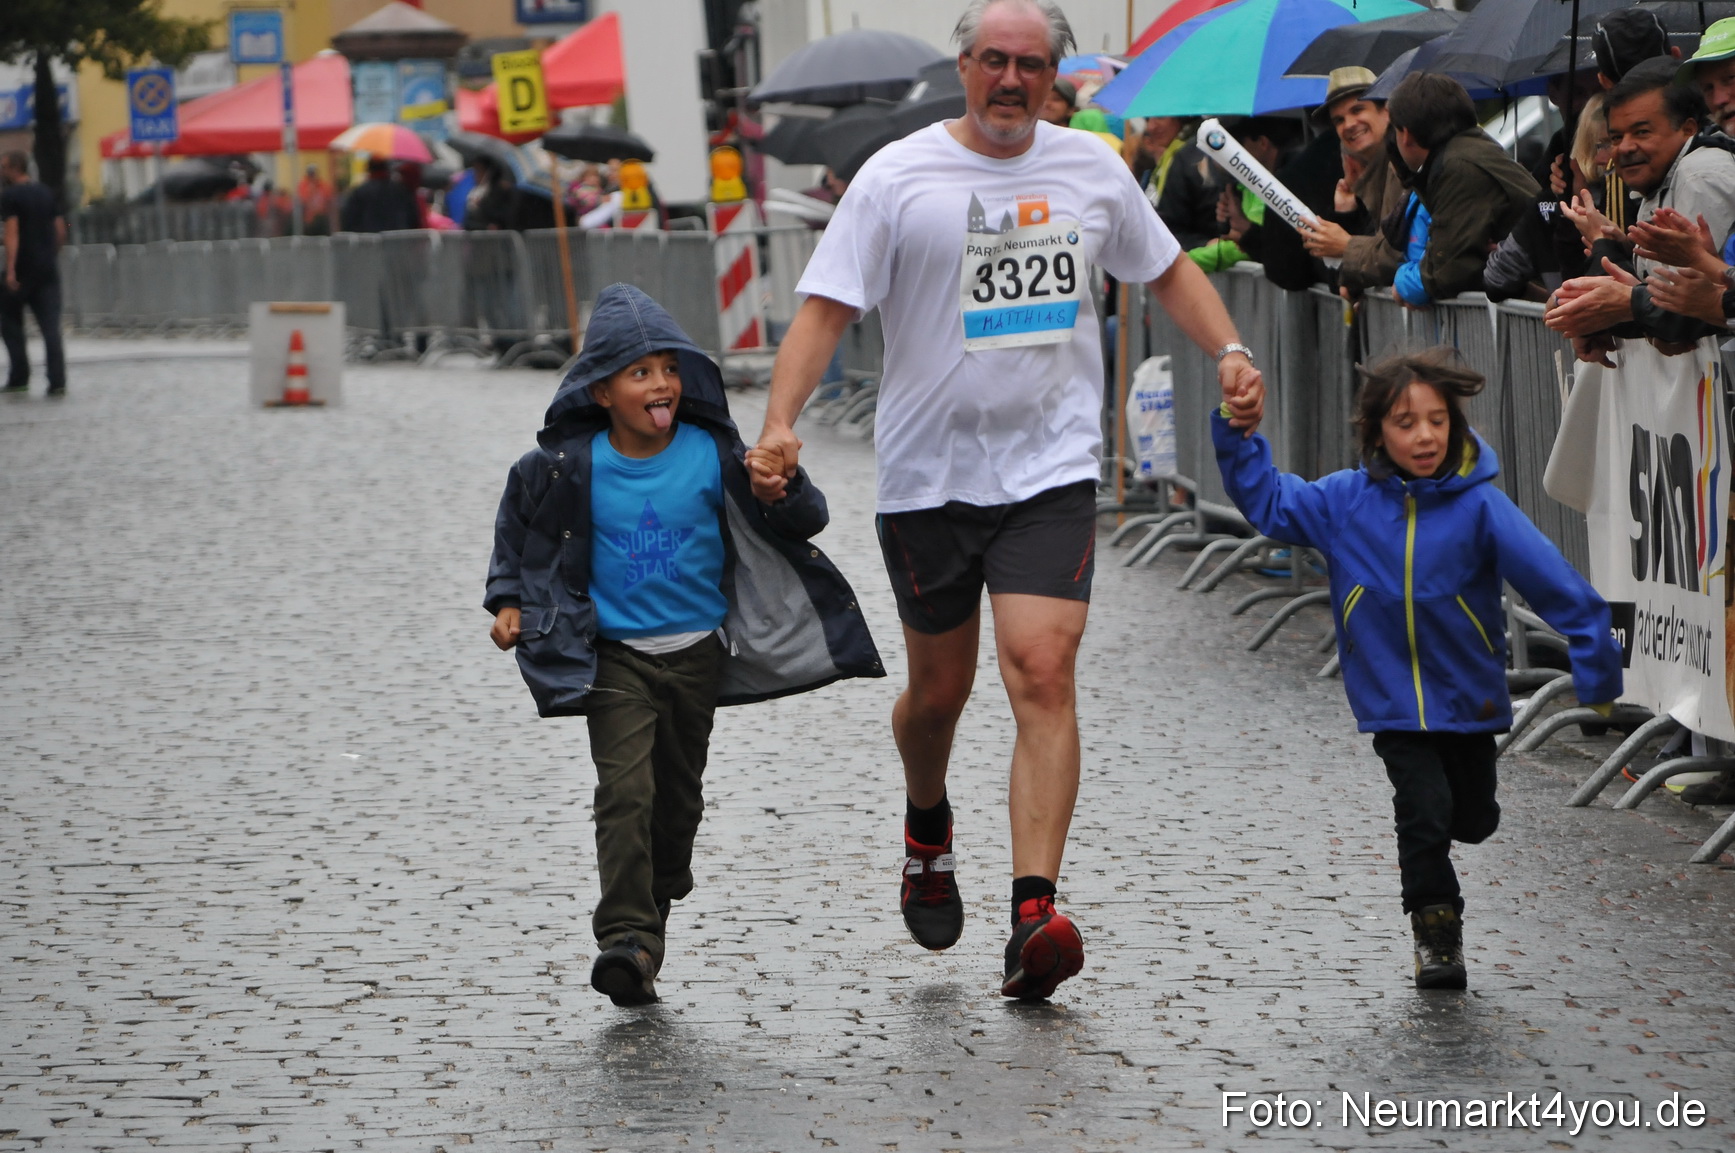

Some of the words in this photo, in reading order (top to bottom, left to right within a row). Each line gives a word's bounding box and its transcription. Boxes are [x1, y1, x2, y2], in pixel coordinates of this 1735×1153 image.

[510, 76, 536, 112] D
[1003, 235, 1063, 251] Neumarkt
[972, 250, 1076, 303] 3329
[982, 309, 1066, 331] MATTHIAS
[618, 529, 682, 554] SUPER
[626, 557, 679, 582] STAR
